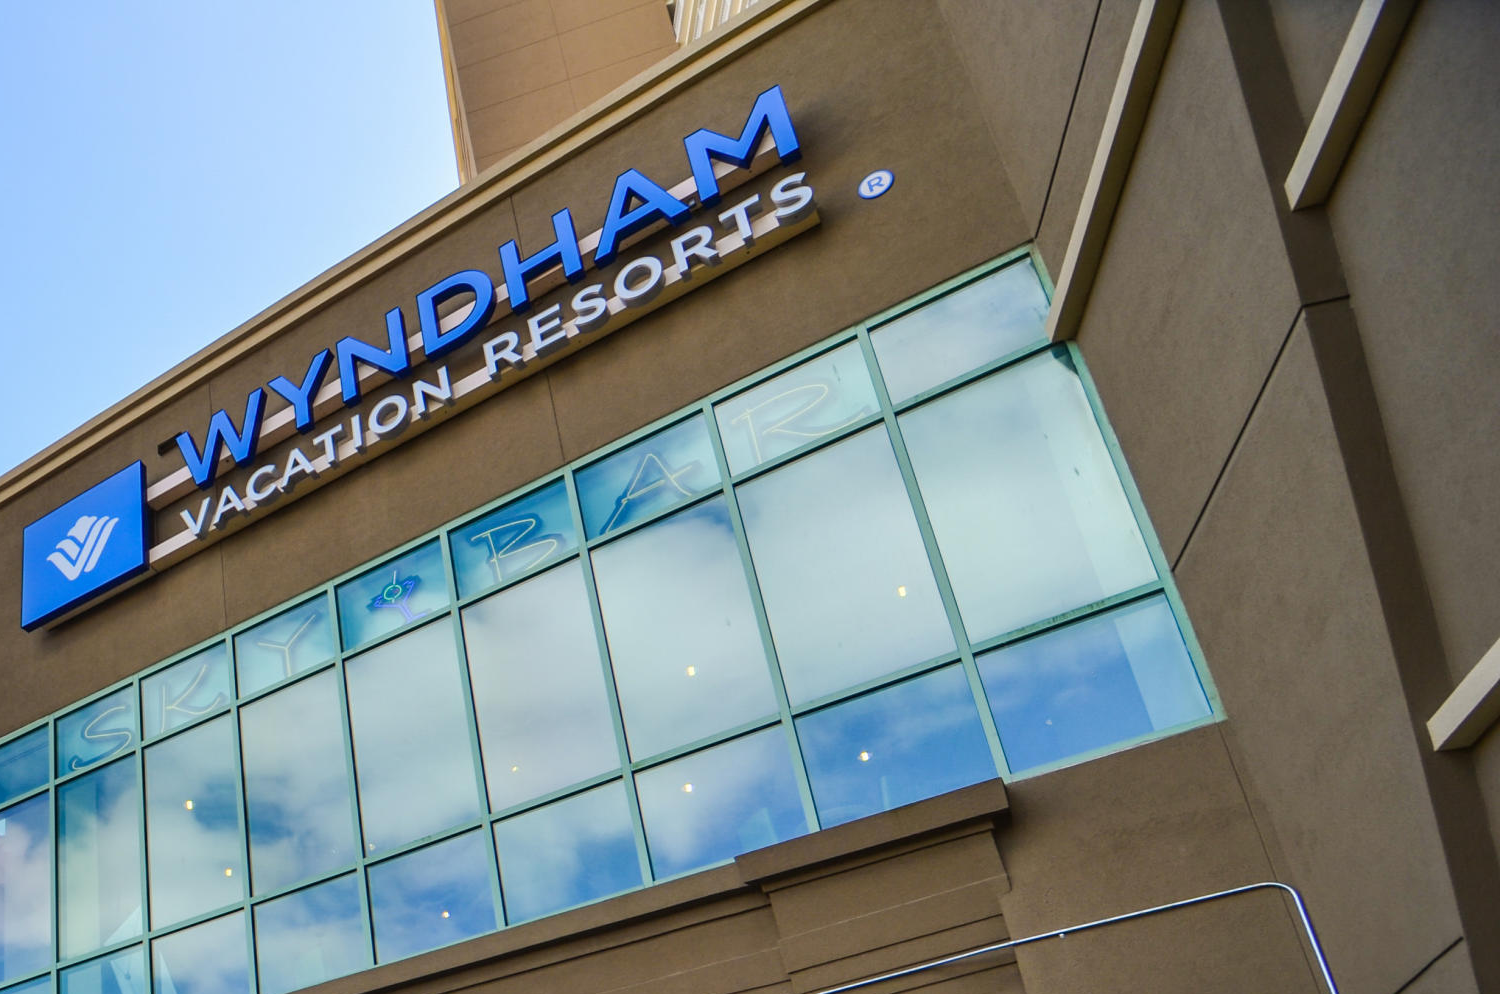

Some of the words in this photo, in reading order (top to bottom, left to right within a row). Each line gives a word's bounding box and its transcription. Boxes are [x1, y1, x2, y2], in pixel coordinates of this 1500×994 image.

[175, 84, 802, 488] WYNDHAM
[180, 366, 453, 542] VACATION
[484, 170, 816, 380] RESORTS
[72, 613, 318, 771] SKY
[470, 383, 866, 583] BAR
